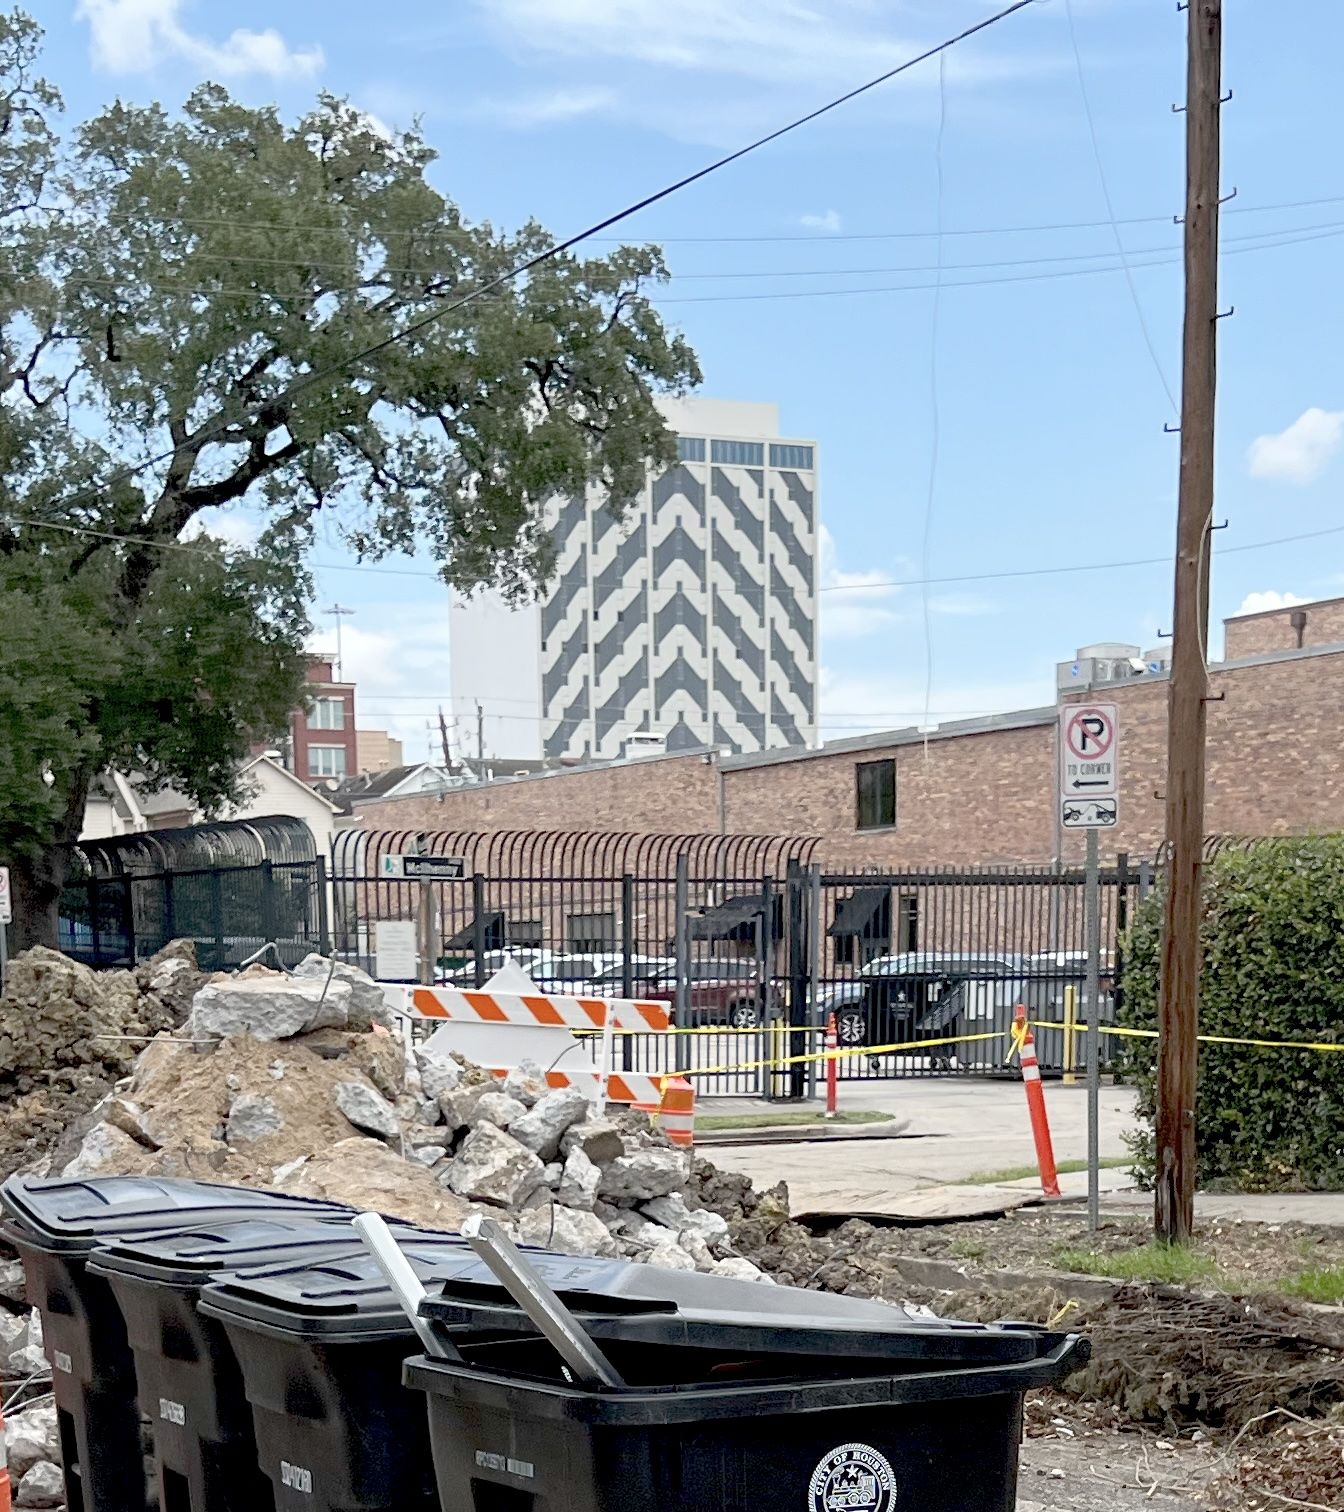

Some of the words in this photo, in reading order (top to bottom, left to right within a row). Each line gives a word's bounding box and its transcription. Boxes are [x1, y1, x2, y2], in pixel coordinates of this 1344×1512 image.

[814, 1465, 832, 1496] CITY
[833, 1452, 849, 1465] OF
[852, 1451, 891, 1491] HOUSTON
